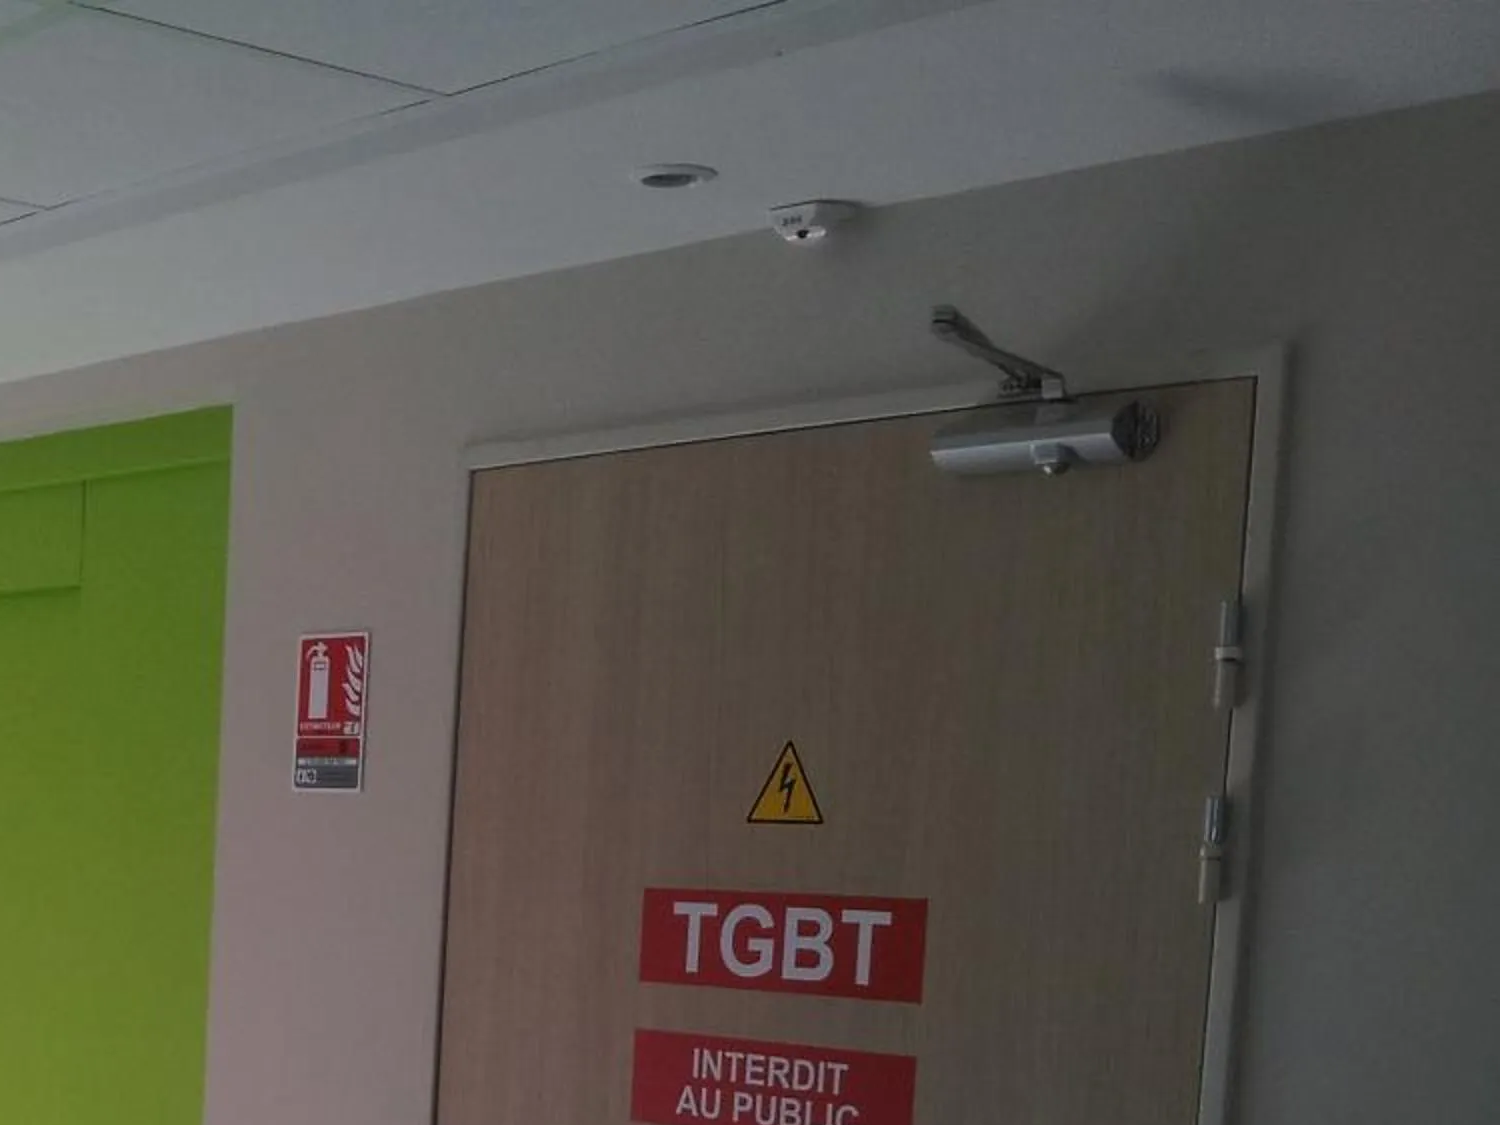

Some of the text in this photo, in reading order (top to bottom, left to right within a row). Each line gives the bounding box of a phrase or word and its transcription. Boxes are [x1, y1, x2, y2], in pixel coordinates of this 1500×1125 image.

[673, 901, 893, 987] TGBT
[692, 1048, 849, 1096] INTERDIT
[675, 1085, 721, 1120] AU
